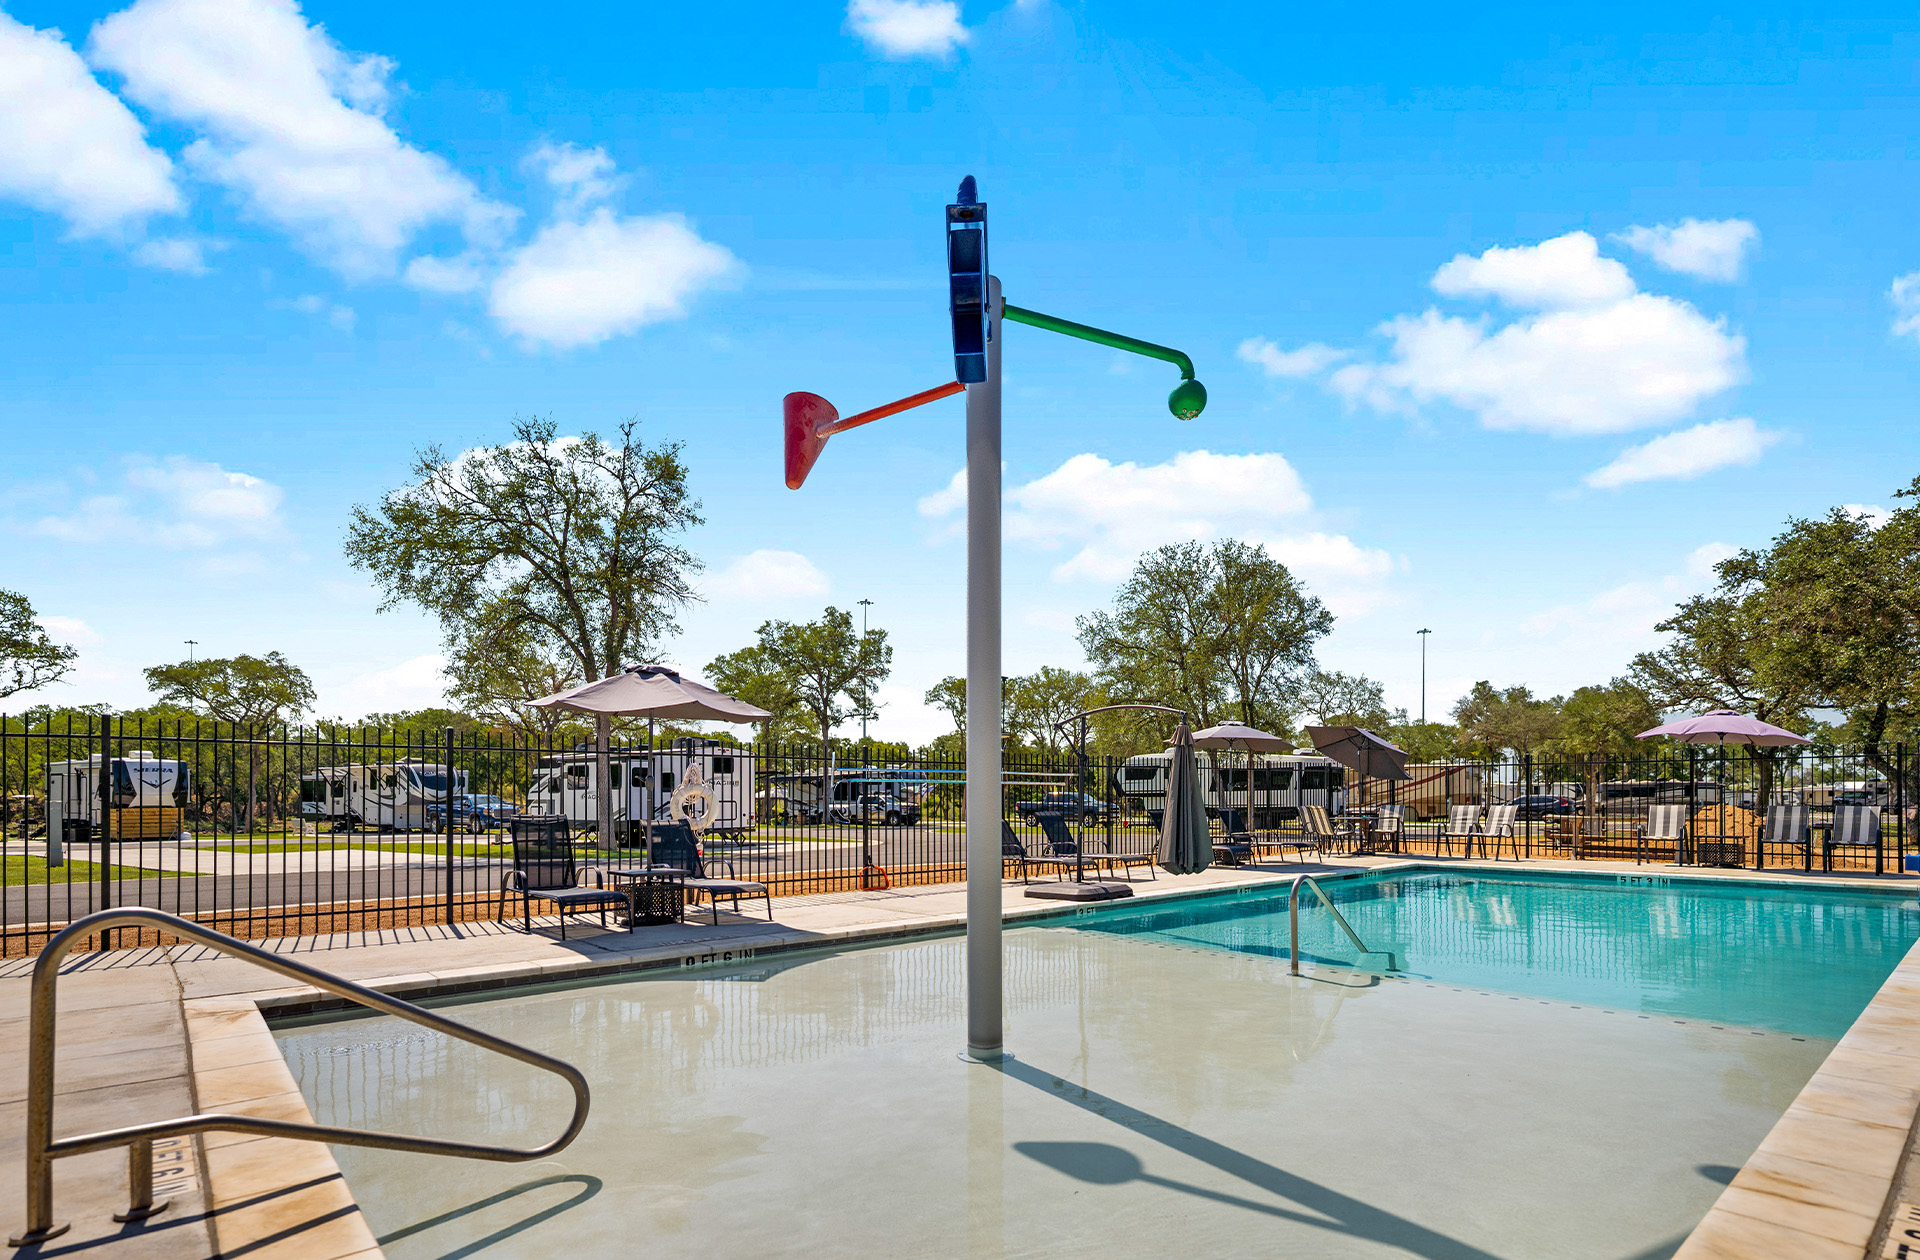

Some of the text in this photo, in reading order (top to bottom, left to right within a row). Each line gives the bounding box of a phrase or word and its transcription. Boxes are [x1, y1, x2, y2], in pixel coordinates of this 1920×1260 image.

[701, 953, 717, 964] FT
[723, 951, 733, 961] 6
[739, 948, 752, 959] IN
